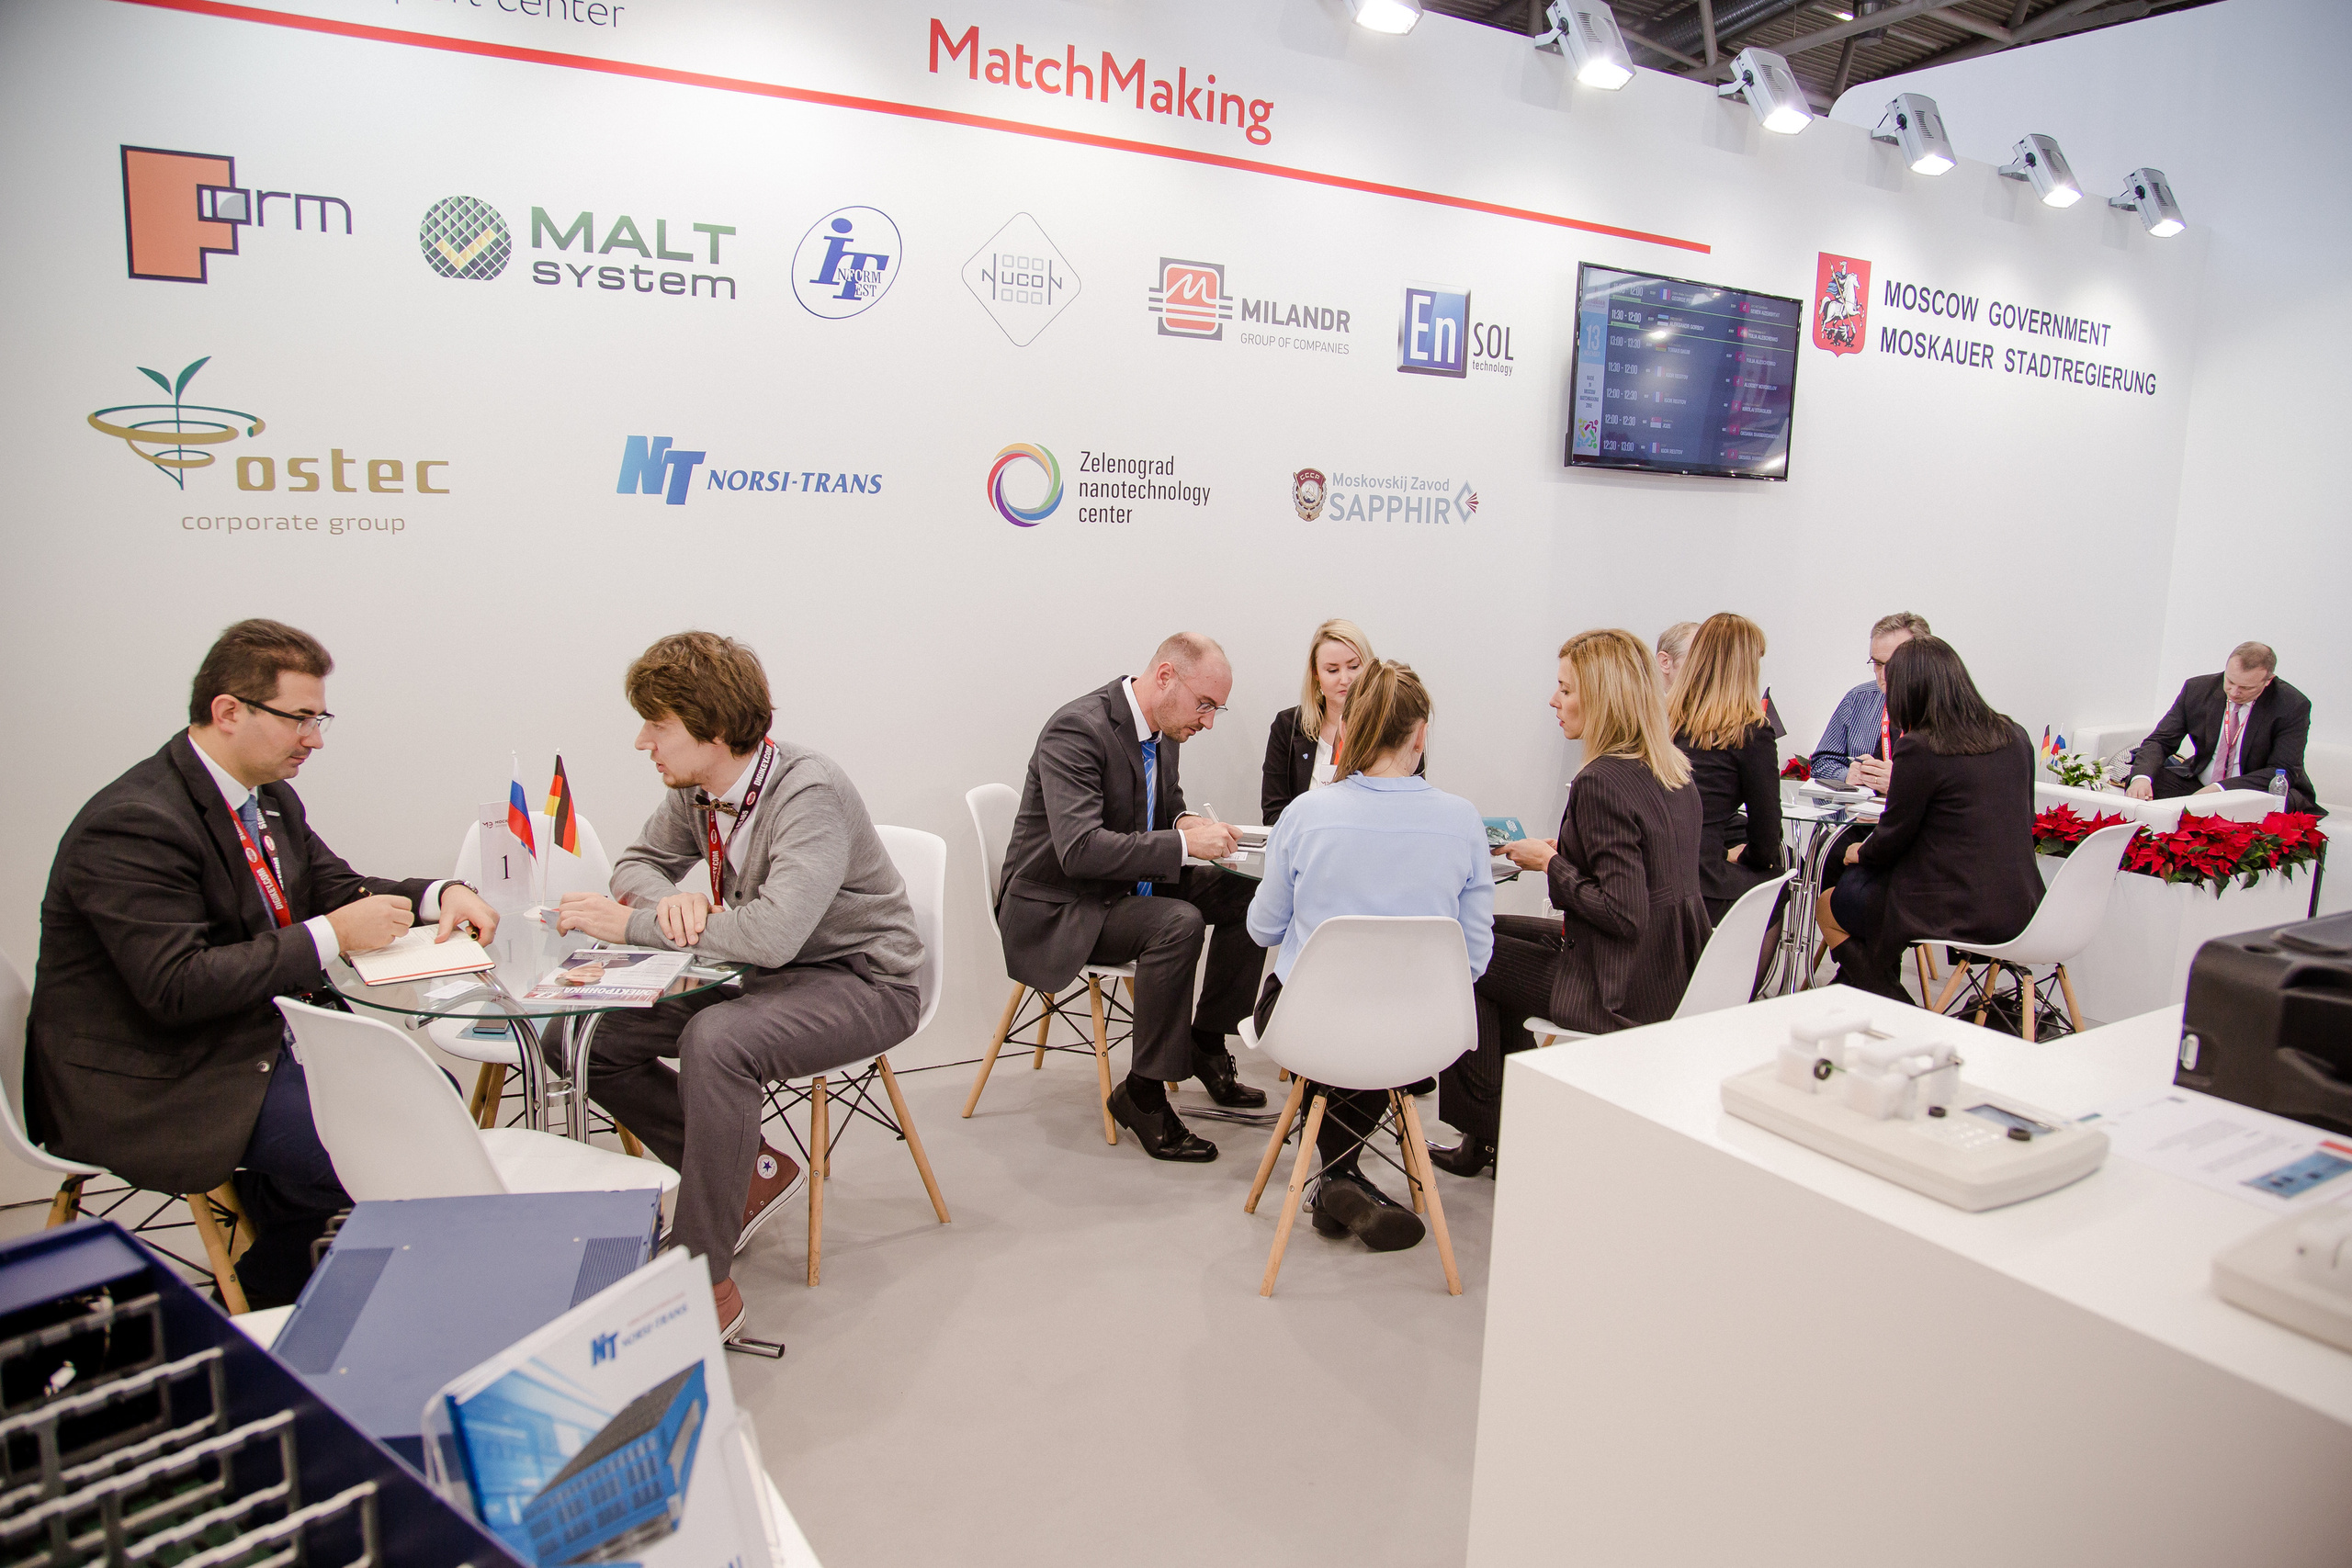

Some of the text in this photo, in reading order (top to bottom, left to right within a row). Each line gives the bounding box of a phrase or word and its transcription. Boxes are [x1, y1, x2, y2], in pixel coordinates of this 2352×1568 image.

[928, 17, 1274, 146] MatchMaking
[531, 206, 737, 265] MALT
[1241, 298, 1351, 333] MILANDR
[1611, 309, 1623, 320] 11:30
[1628, 311, 1642, 322] 12:00
[1883, 279, 2111, 347] MOSCOW GOVERNMENT
[1409, 294, 1457, 364] En
[1473, 321, 1514, 361] SOL
[1586, 324, 1600, 351] 13
[1610, 335, 1623, 346] 13:00
[1627, 337, 1641, 348] 13:30
[1240, 333, 1350, 355] GROUP OF COMPANIES
[1472, 360, 1513, 377] technology
[1608, 361, 1620, 372] 11:30
[1624, 364, 1637, 375] 12:00
[1880, 326, 2156, 396] MOSKAUER STADTREGIERUNG
[1606, 388, 1620, 399] 12:00
[1623, 389, 1637, 400] 12:30
[1604, 413, 1619, 424] 12:00
[1623, 415, 1636, 426] 12:30
[1603, 440, 1617, 451] 12:30
[1621, 441, 1634, 452] 13:00
[236, 448, 450, 494] ostec
[616, 434, 883, 505] NT NORSI-TRANS
[1080, 450, 1174, 479] Zelenograd
[1079, 479, 1211, 506] nanotechnology
[1332, 472, 1450, 492] Moskovskij Zavod
[1079, 505, 1133, 524] center
[1329, 492, 1450, 525] SAPPHIR
[182, 514, 405, 535] corporate group
[753, 744, 773, 787] DIGIKEY.COM
[501, 853, 512, 881] 1
[256, 867, 284, 910] DIGIKEY.COM
